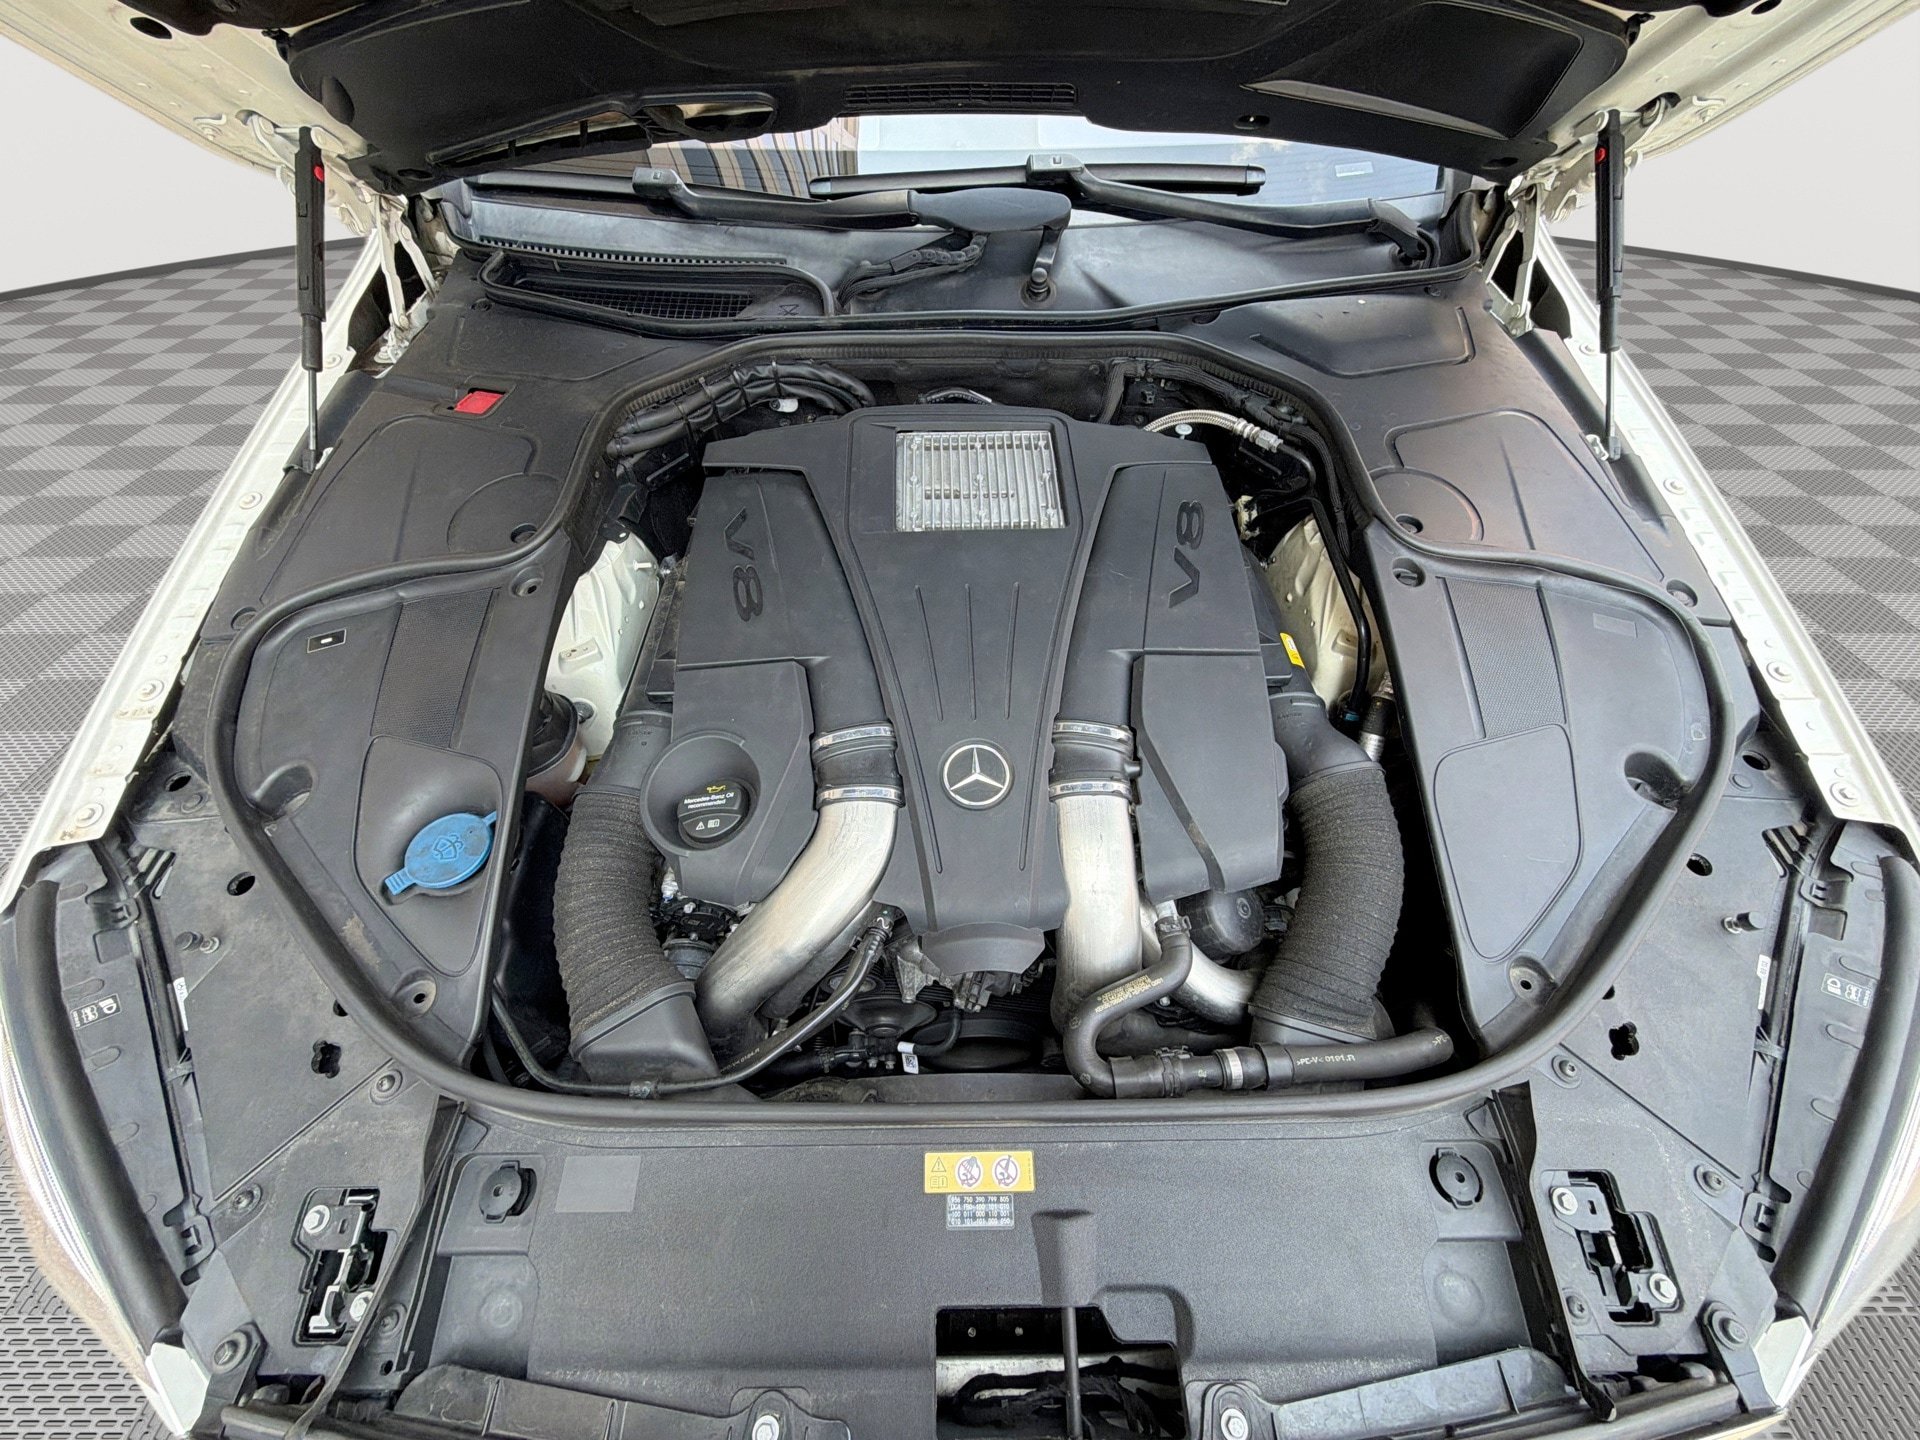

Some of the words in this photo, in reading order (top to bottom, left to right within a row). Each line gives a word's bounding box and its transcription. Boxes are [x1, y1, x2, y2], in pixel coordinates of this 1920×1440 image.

[724, 506, 763, 622] V8
[1168, 500, 1204, 609] V8
[683, 794, 725, 804] Mercedes-Benz
[687, 799, 726, 809] recommended
